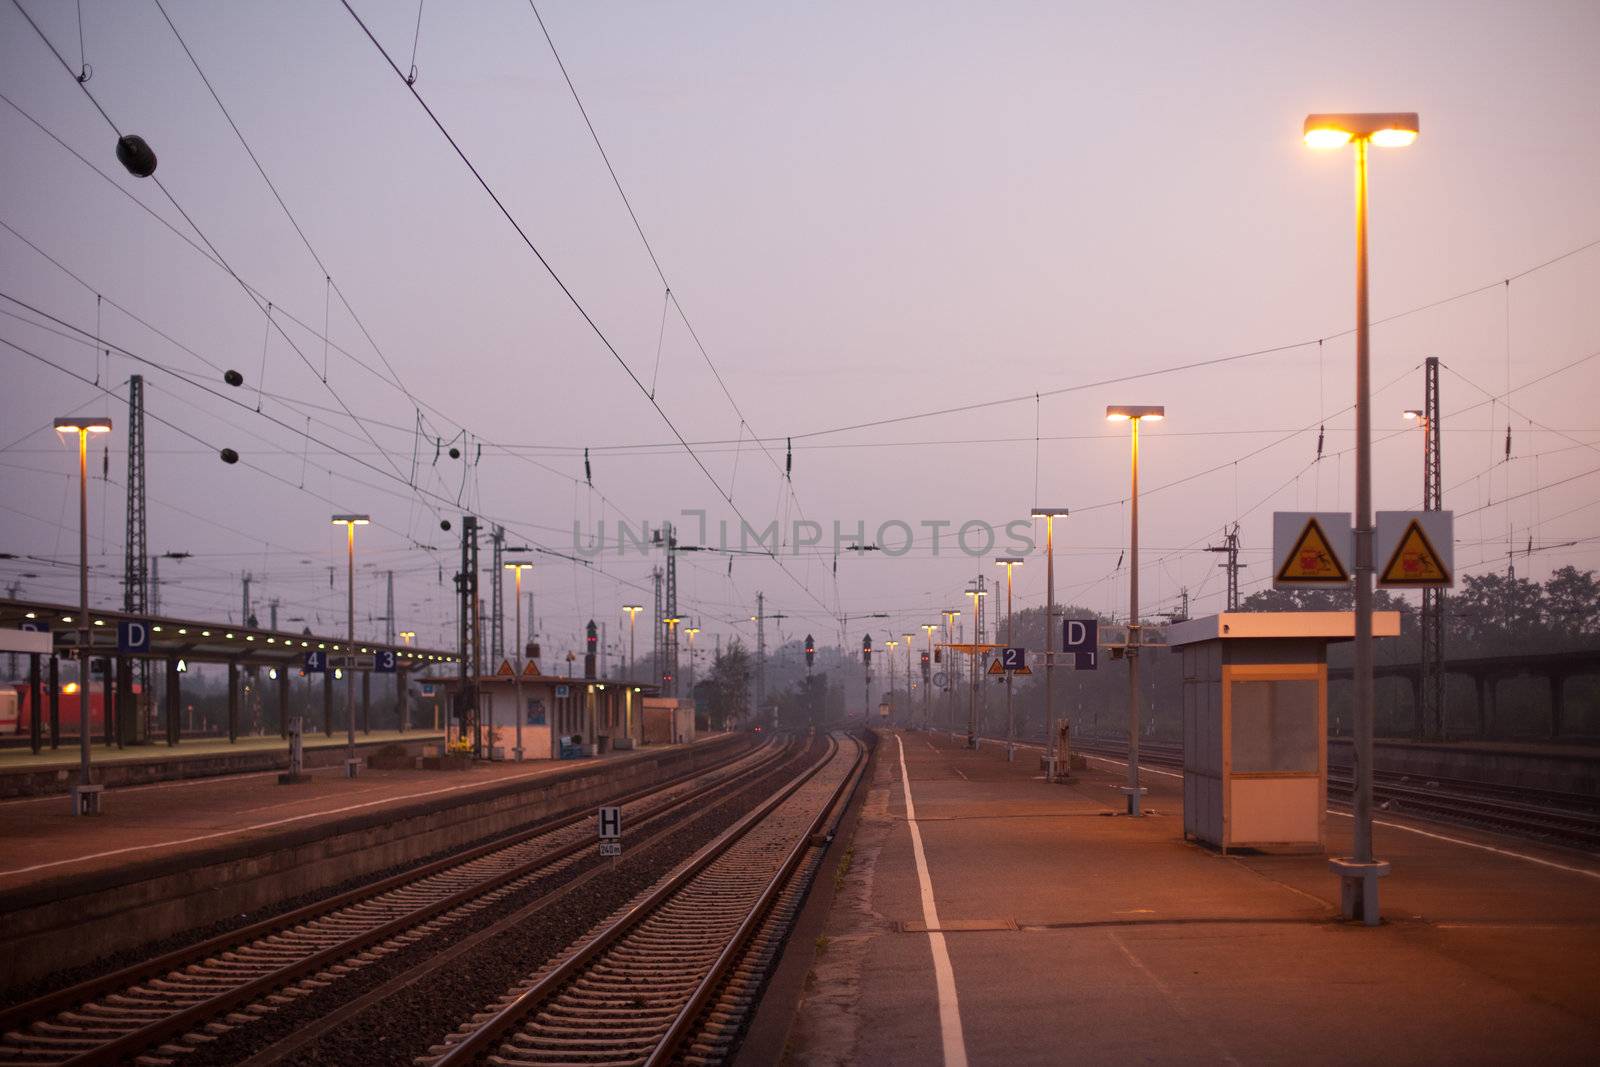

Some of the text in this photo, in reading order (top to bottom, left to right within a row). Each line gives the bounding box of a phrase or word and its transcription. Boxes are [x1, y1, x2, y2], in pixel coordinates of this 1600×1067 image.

[128, 623, 145, 647] D
[1068, 621, 1086, 645] D
[308, 652, 319, 668] 4
[383, 651, 394, 668] 3
[1005, 648, 1017, 666] 2
[1087, 652, 1095, 665] 1
[601, 809, 618, 835] H
